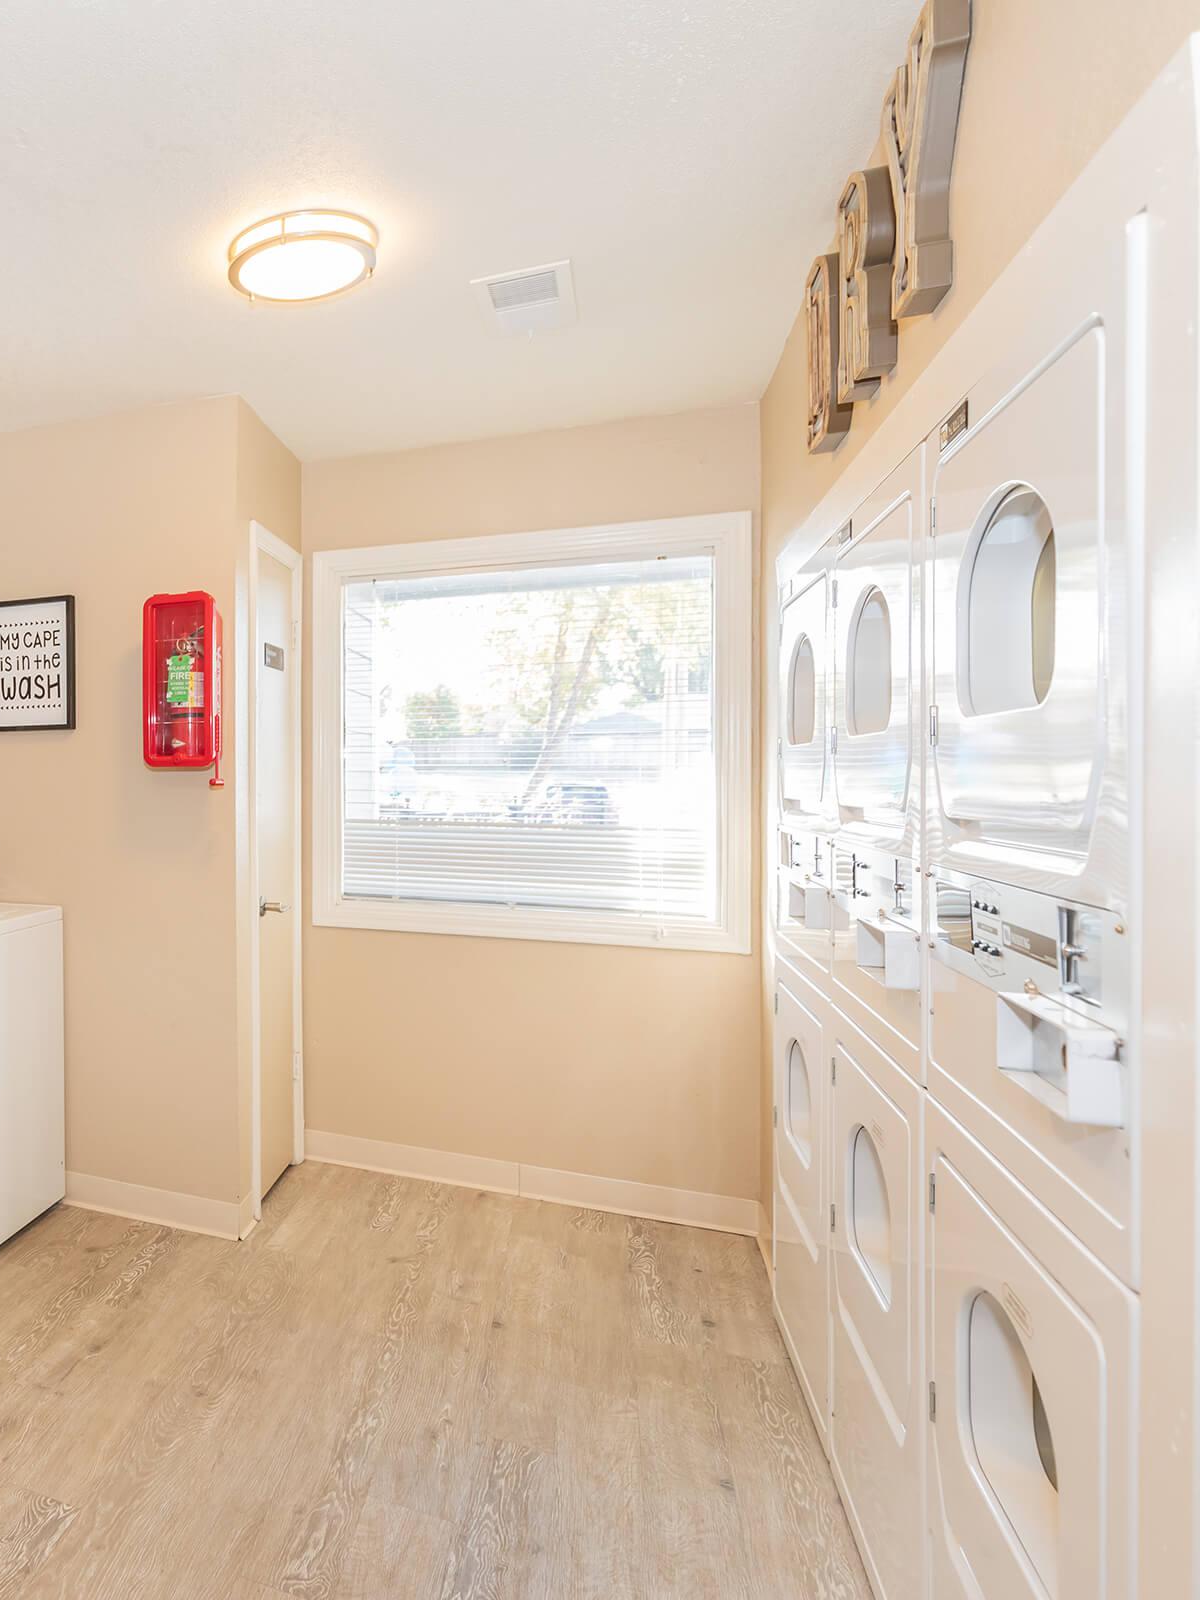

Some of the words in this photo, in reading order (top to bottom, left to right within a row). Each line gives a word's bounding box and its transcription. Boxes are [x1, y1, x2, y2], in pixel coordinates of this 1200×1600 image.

[23, 629, 61, 648] CAPE
[0, 656, 13, 672] is
[16, 655, 30, 671] in
[34, 653, 61, 670] the
[170, 672, 190, 681] FIRE
